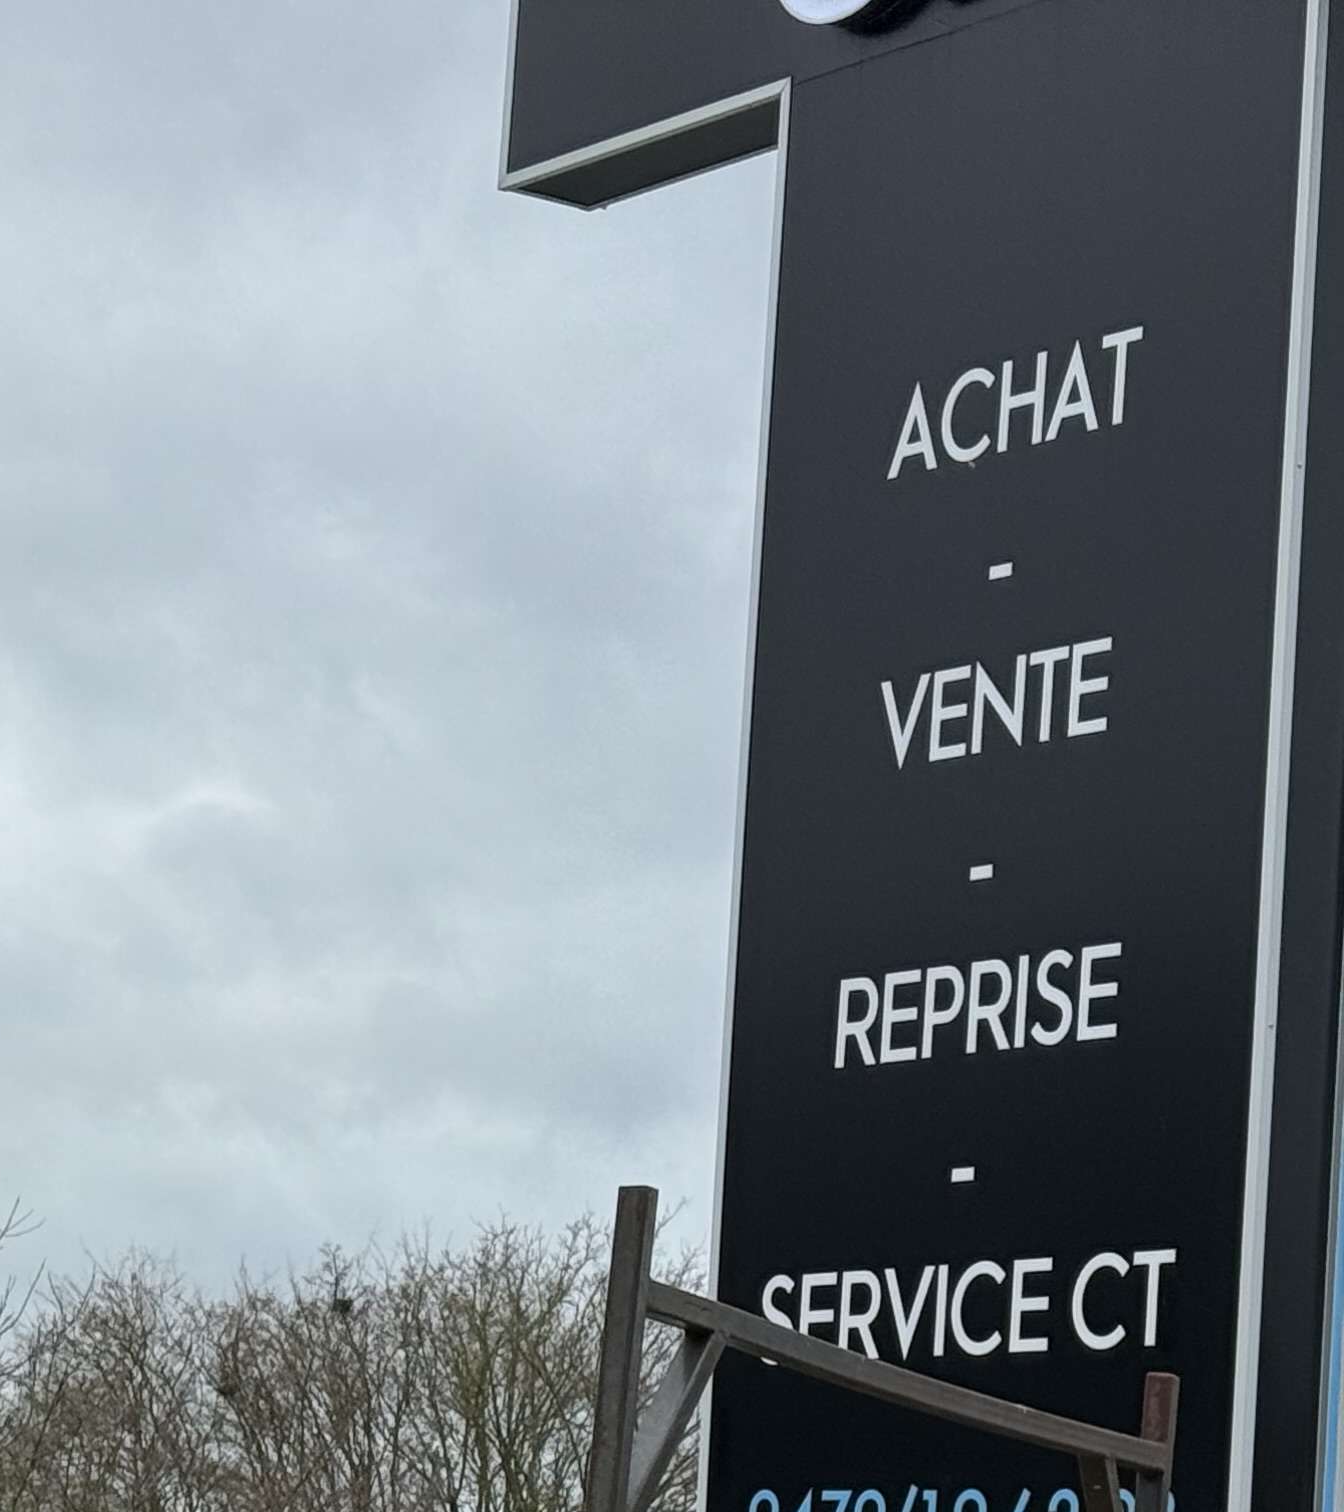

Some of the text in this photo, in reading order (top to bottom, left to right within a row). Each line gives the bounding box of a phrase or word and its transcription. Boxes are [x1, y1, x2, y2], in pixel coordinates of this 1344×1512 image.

[887, 325, 1144, 480] ACHAT
[880, 636, 1113, 769] VENTE
[834, 942, 1122, 1069] REPRISE
[761, 1248, 1177, 1366] SERVICE CT
